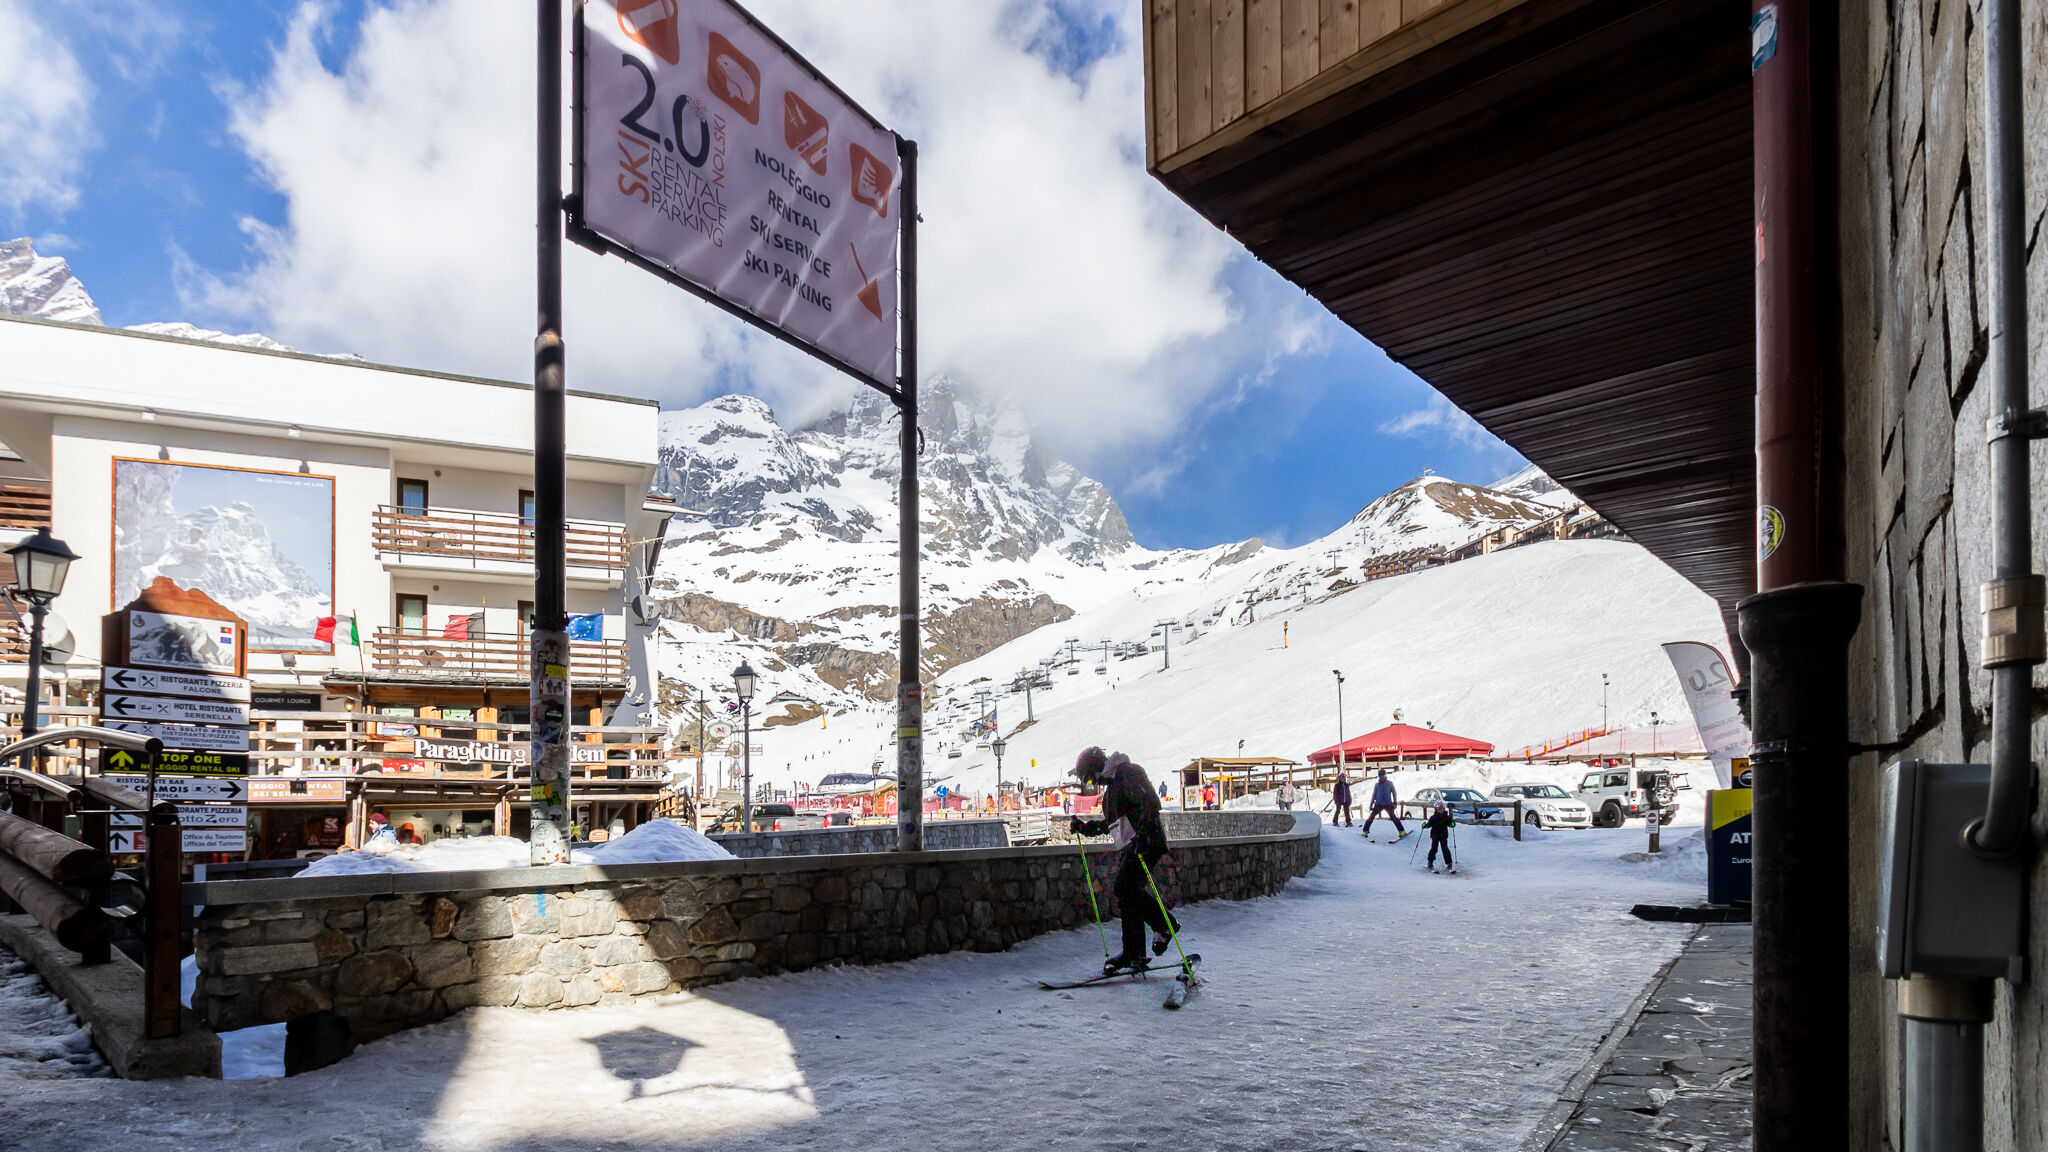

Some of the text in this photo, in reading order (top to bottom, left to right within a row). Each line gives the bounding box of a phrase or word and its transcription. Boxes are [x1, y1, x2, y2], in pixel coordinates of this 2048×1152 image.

[619, 53, 711, 168] 2.0
[618, 130, 650, 204] SKI
[651, 147, 721, 203] RENTAL
[711, 113, 727, 188] NOLSKI
[651, 171, 728, 226] SERVICE
[754, 148, 831, 209] NOLEGGIO
[651, 191, 724, 248] PARKING
[768, 189, 821, 236] RENTAL
[750, 215, 831, 279] SKI SERVICE
[743, 250, 832, 313] SKI PARKING
[160, 675, 243, 689] RISTORANTE PIZZERIA
[183, 686, 222, 695] FALCONE
[174, 703, 242, 714] HOTEL RISTORANTE
[184, 712, 232, 721] SERENELLA
[141, 763, 188, 771] NEGGIO
[190, 765, 224, 773] RENTAL
[161, 753, 222, 764] TOP ONE
[414, 738, 605, 766] Paragliding dem
[1730, 832, 1752, 844] AT
